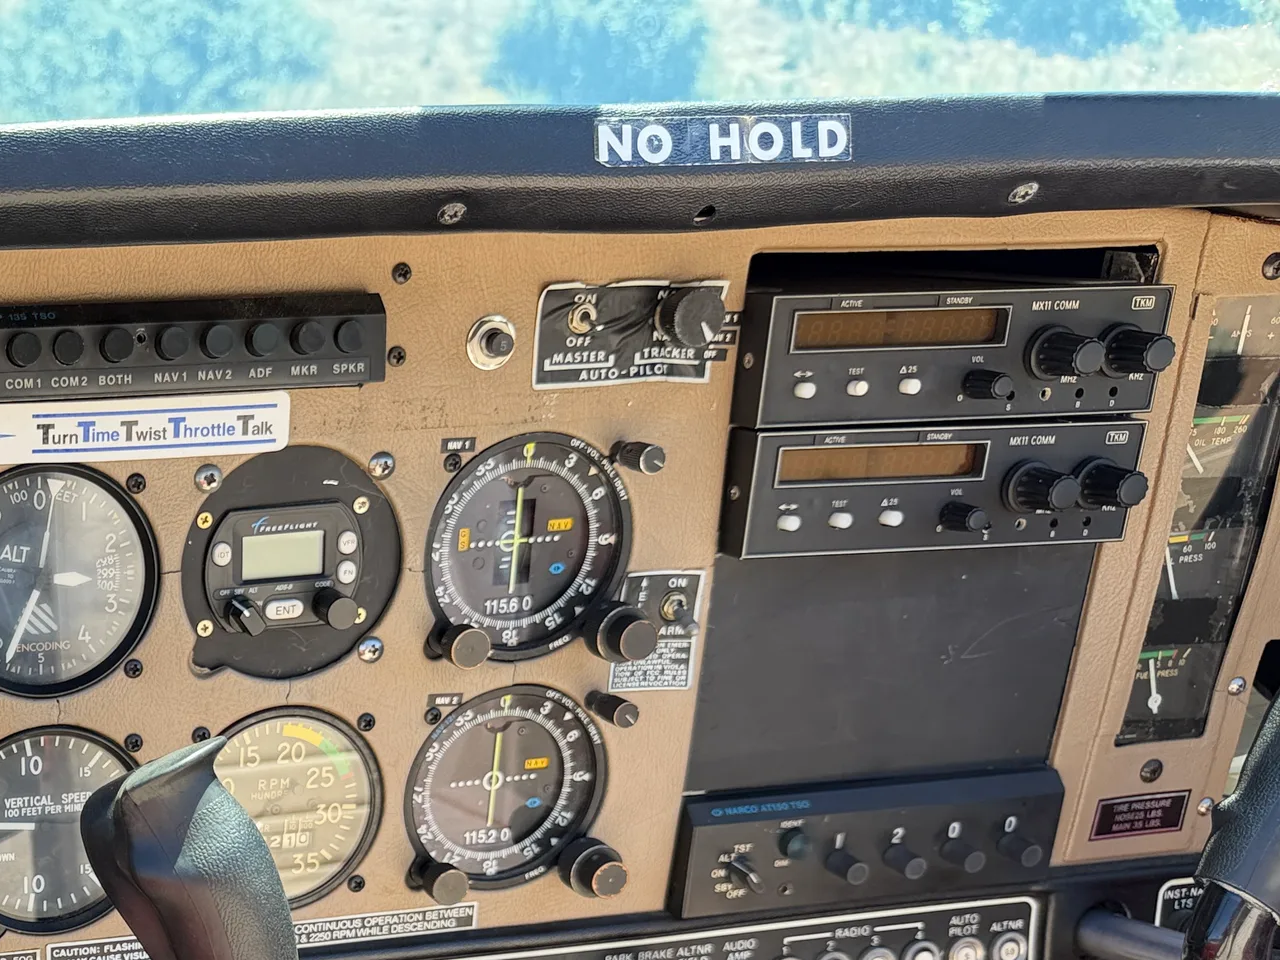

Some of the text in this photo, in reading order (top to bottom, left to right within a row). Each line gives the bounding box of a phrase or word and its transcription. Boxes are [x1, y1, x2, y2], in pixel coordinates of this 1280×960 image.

[598, 120, 847, 163] NO HOLD
[574, 293, 598, 305] ON
[840, 296, 973, 308] ACTIVE STANDBY
[1032, 300, 1079, 311] MX11 COMM
[1134, 298, 1153, 308] TKM
[32, 312, 56, 320] TSO
[566, 336, 593, 347] OFF
[552, 351, 605, 364] MASTER
[643, 347, 696, 360] TRACKER
[249, 367, 273, 379] ADF
[291, 365, 317, 376] MKR
[332, 363, 365, 375] SPKR
[579, 365, 669, 381] AUTO-PILOT
[99, 374, 132, 386] BOTH
[37, 414, 273, 445] Turn Time Twist Throttle Talk
[1031, 435, 1056, 445] COMM
[1108, 433, 1127, 443] TKM
[0, 544, 30, 563] ALT
[668, 578, 688, 588] ON
[275, 605, 297, 617] ENT
[16, 640, 71, 653] ENCODING
[238, 746, 261, 768] 15
[276, 741, 306, 764] 20
[20, 755, 43, 776] 10
[306, 767, 335, 789] 25
[4, 794, 54, 808] VERTICAL
[22, 805, 61, 816] FEET PER
[314, 803, 342, 825] 30
[724, 804, 758, 816] NARCO
[291, 853, 320, 874] 35
[24, 875, 45, 894] 10
[1174, 898, 1193, 909] LTS
[295, 907, 472, 934] CONTINUOUS OPERATION BETWEEN
[949, 914, 978, 926] AUTO
[990, 919, 1023, 932] ALTNR
[333, 918, 456, 939] RPM WHILE DESCENDING
[835, 925, 870, 939] RADIO
[949, 925, 978, 937] PILOT
[52, 945, 101, 958] CAUTION:
[676, 944, 713, 957] ALTNR
[723, 939, 756, 952] AUDIO
